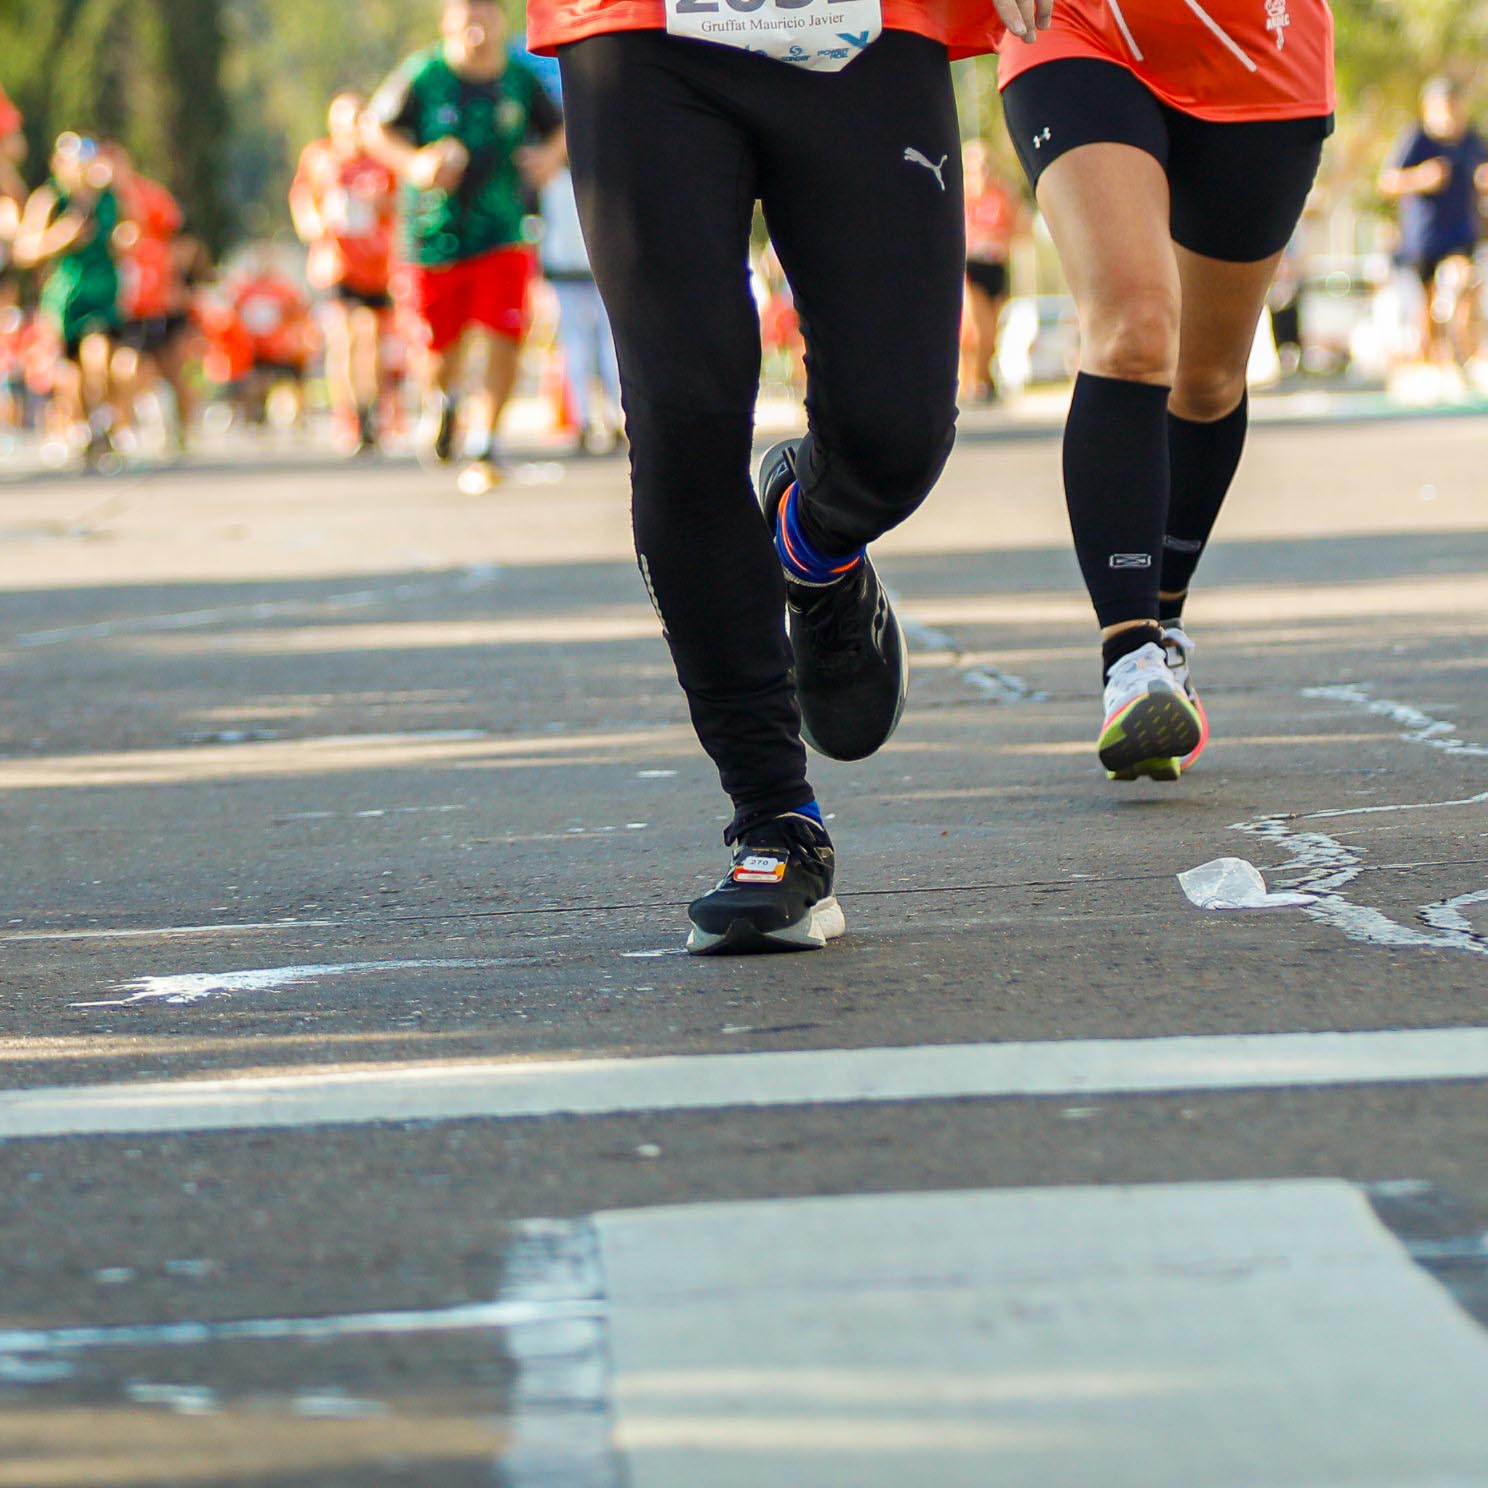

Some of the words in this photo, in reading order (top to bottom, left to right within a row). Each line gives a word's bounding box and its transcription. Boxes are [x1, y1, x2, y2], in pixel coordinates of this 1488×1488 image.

[701, 19, 746, 33] Gruffat
[750, 16, 806, 31] Mauricio
[809, 13, 844, 26] Javier
